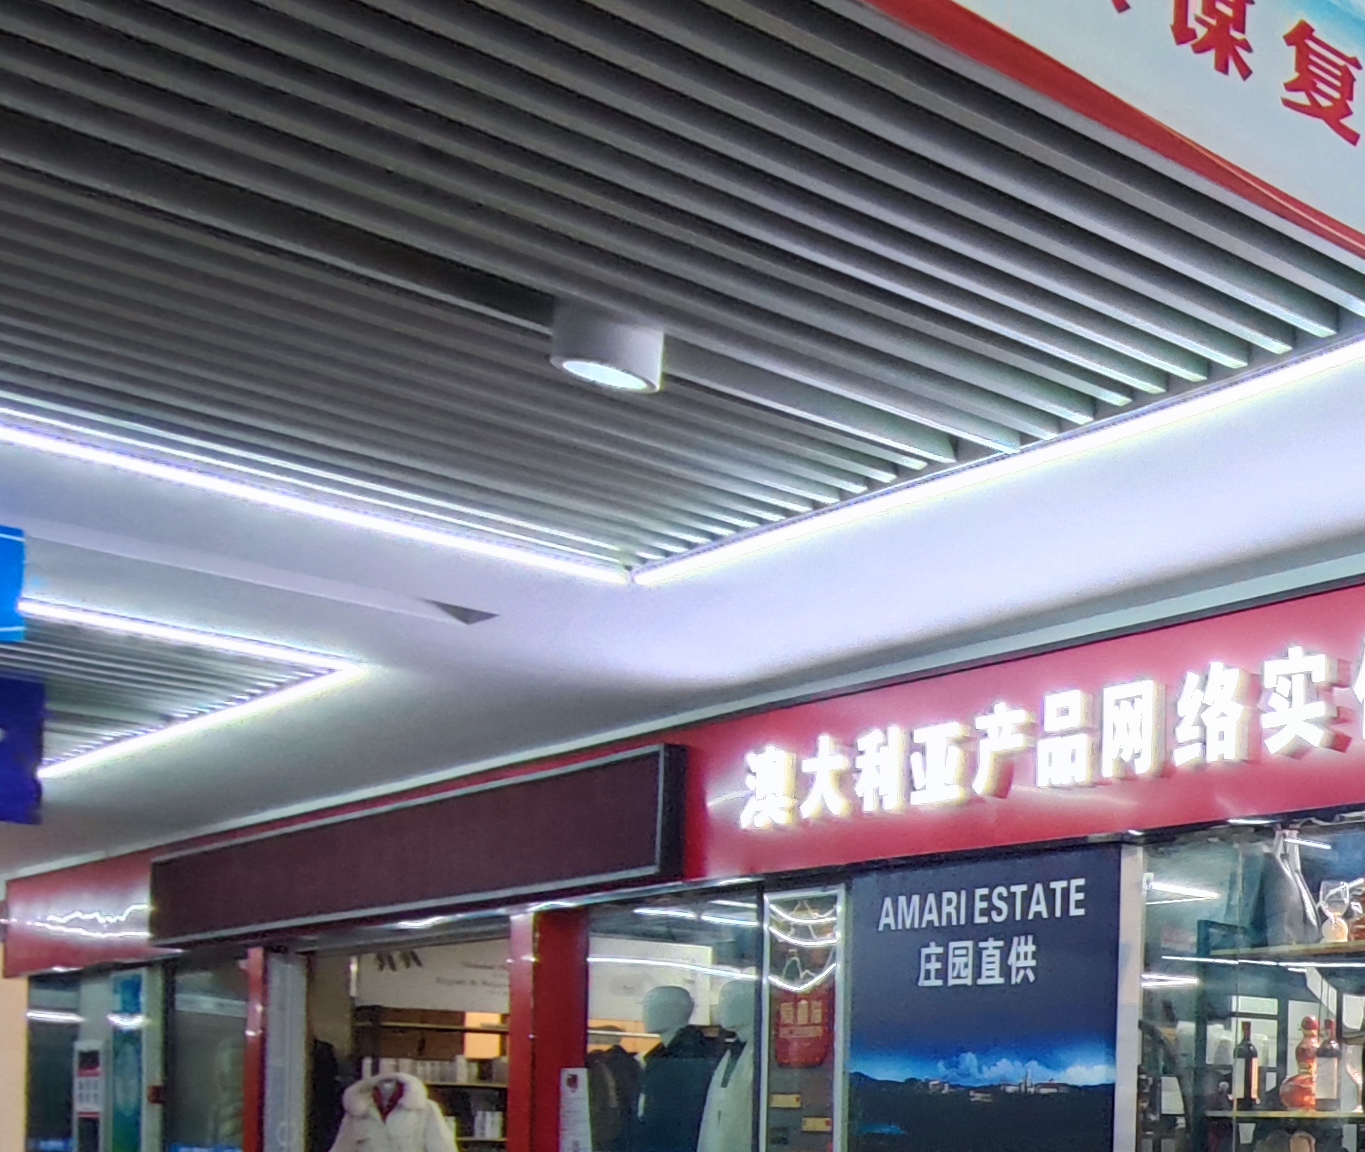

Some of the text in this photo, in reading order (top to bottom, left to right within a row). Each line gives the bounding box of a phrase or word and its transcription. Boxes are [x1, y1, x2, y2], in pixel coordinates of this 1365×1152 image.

[878, 877, 1086, 932] AMARI ESTATE
[917, 934, 1037, 987] 庄园直供
